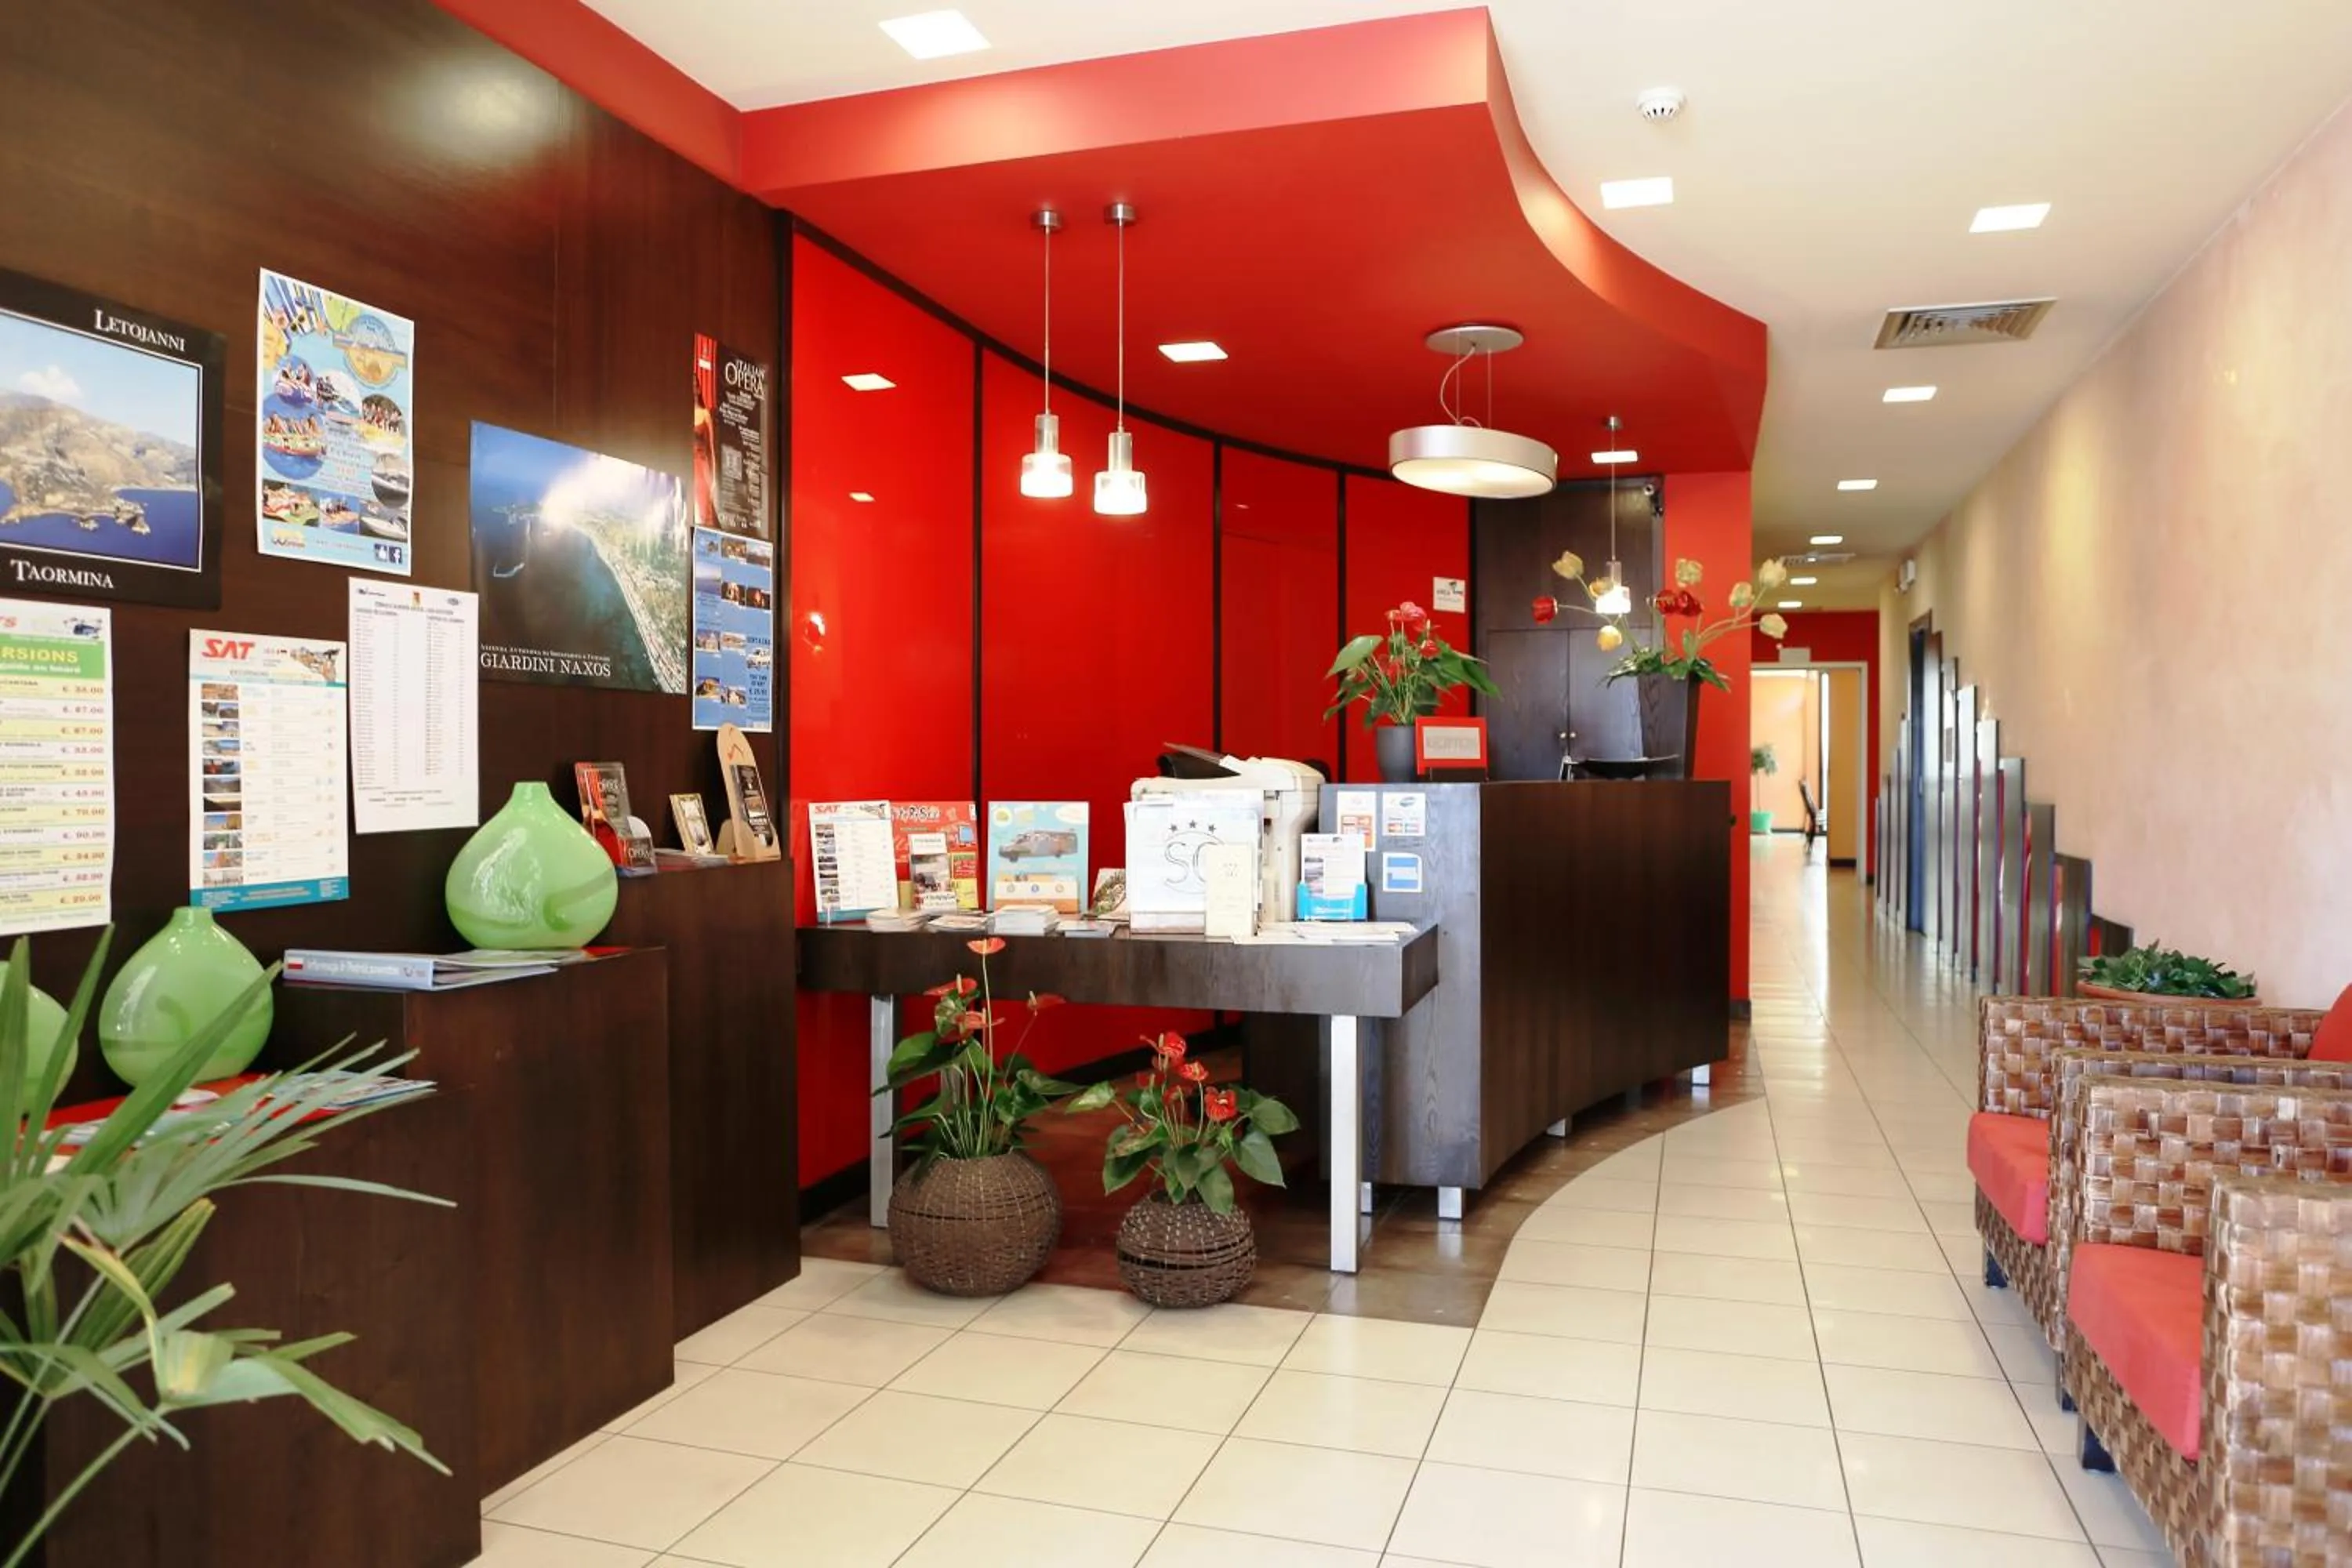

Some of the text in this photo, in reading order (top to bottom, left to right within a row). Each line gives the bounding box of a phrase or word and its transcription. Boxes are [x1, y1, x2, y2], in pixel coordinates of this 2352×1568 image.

[94, 308, 185, 352] LETOJANNI
[724, 361, 764, 396] OPERA
[9, 558, 114, 589] TAORMINA
[201, 638, 255, 660] SAT
[481, 652, 611, 677] GIARDINI NAXOS
[815, 804, 840, 814] SAT
